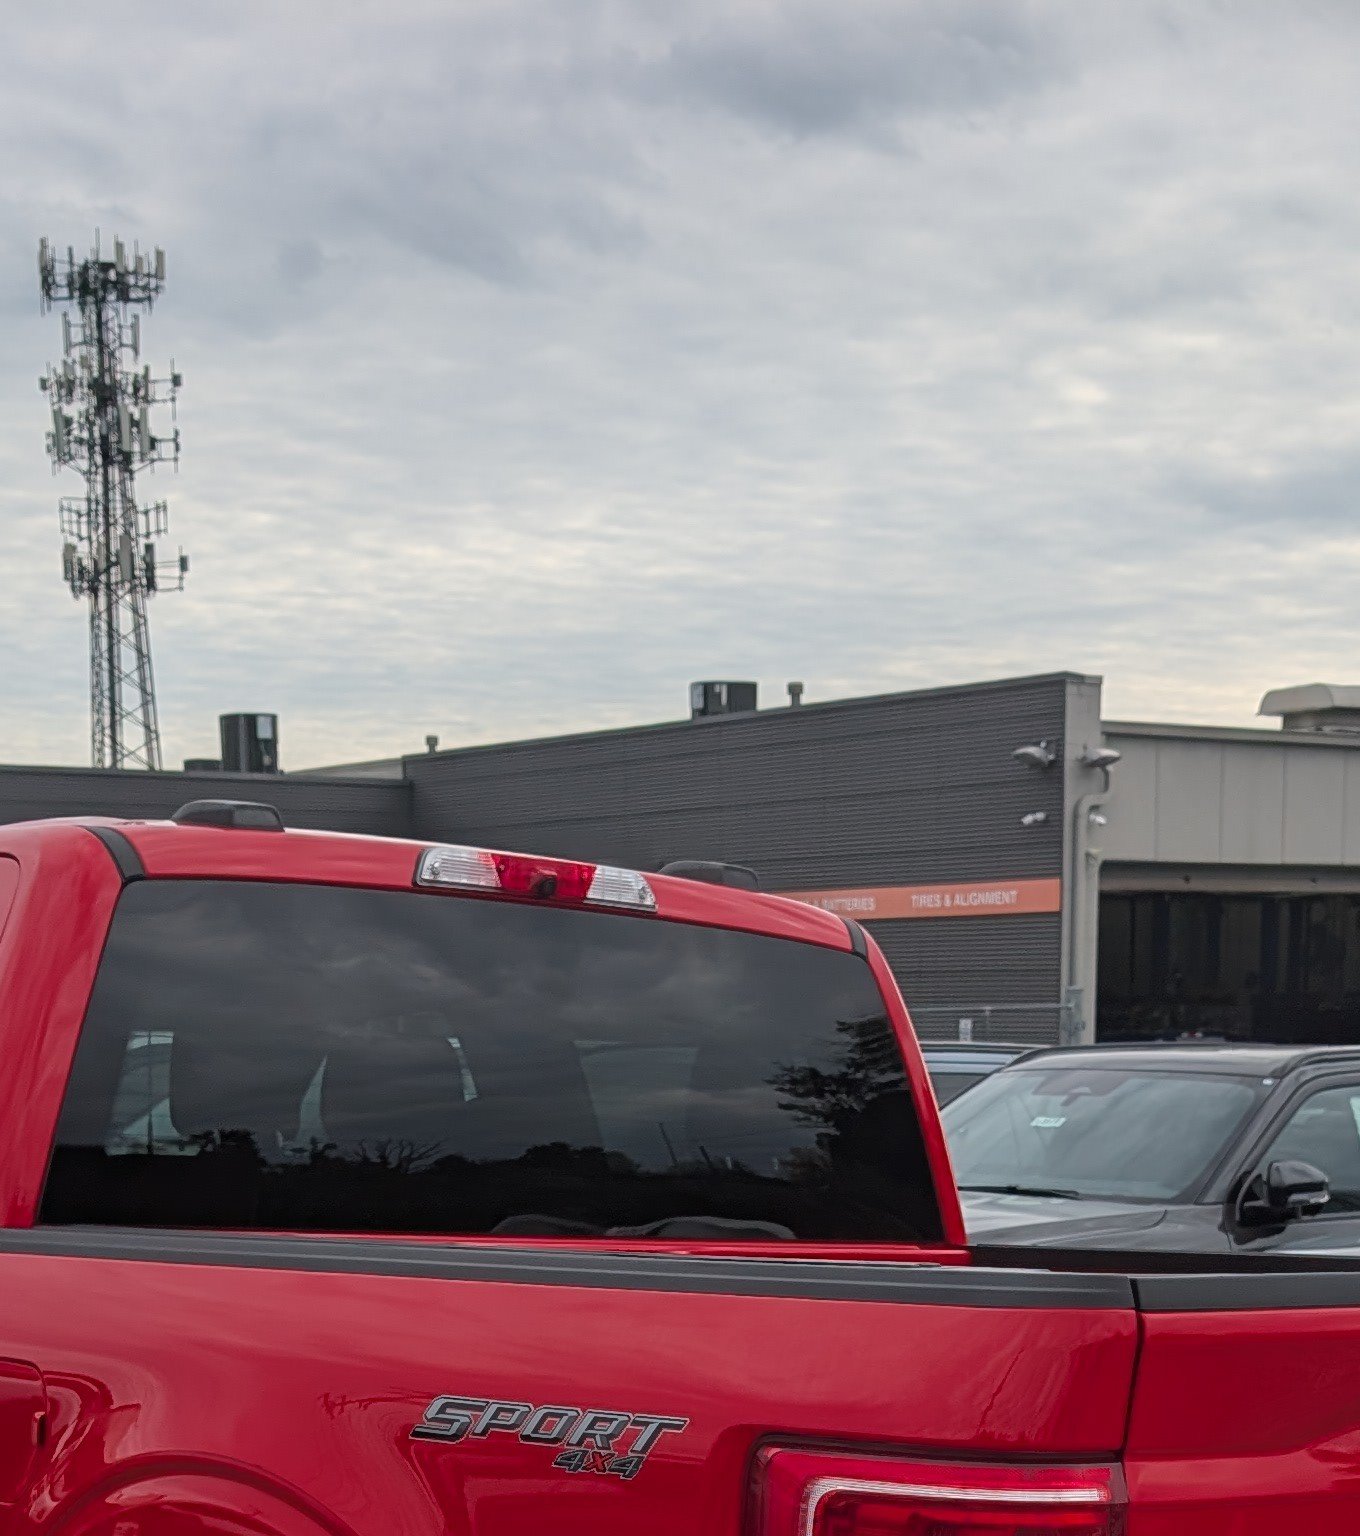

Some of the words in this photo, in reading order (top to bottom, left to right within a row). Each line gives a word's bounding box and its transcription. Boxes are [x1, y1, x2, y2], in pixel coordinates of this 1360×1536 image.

[911, 893, 942, 908] TIRES
[943, 893, 952, 907] &
[953, 890, 1018, 906] ALIGNMENT
[409, 1394, 690, 1455] SPORT
